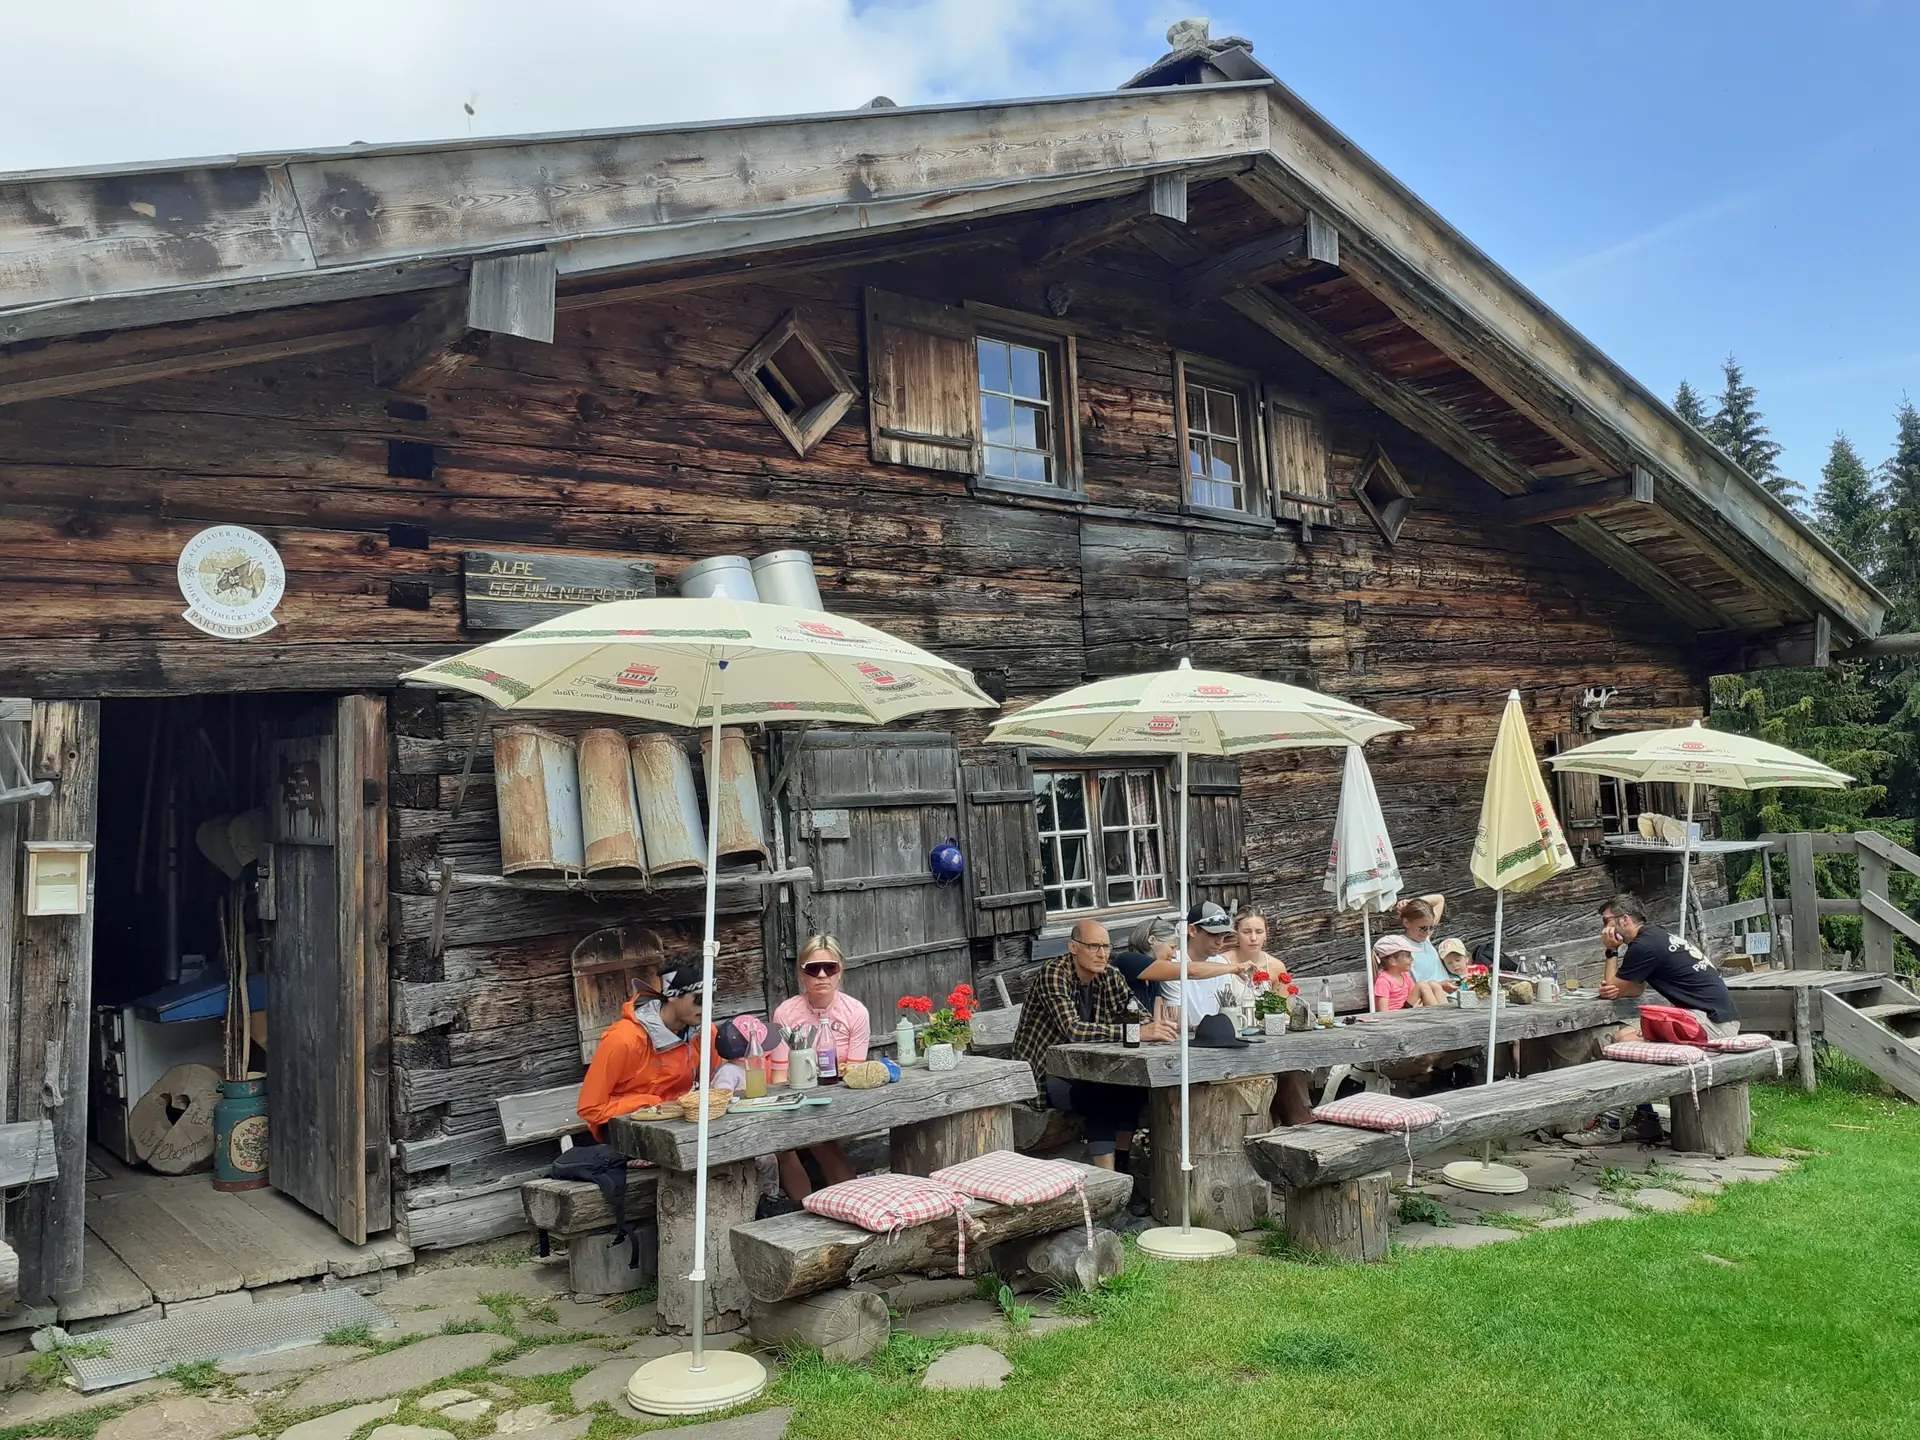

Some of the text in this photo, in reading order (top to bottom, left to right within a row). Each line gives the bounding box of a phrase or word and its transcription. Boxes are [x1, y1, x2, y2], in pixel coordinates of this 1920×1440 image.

[188, 531, 279, 570] ALLGÄUER ALPGENUSS
[489, 560, 534, 576] ALPE
[186, 583, 203, 605] HIER
[190, 610, 272, 635] PARTNERALPE
